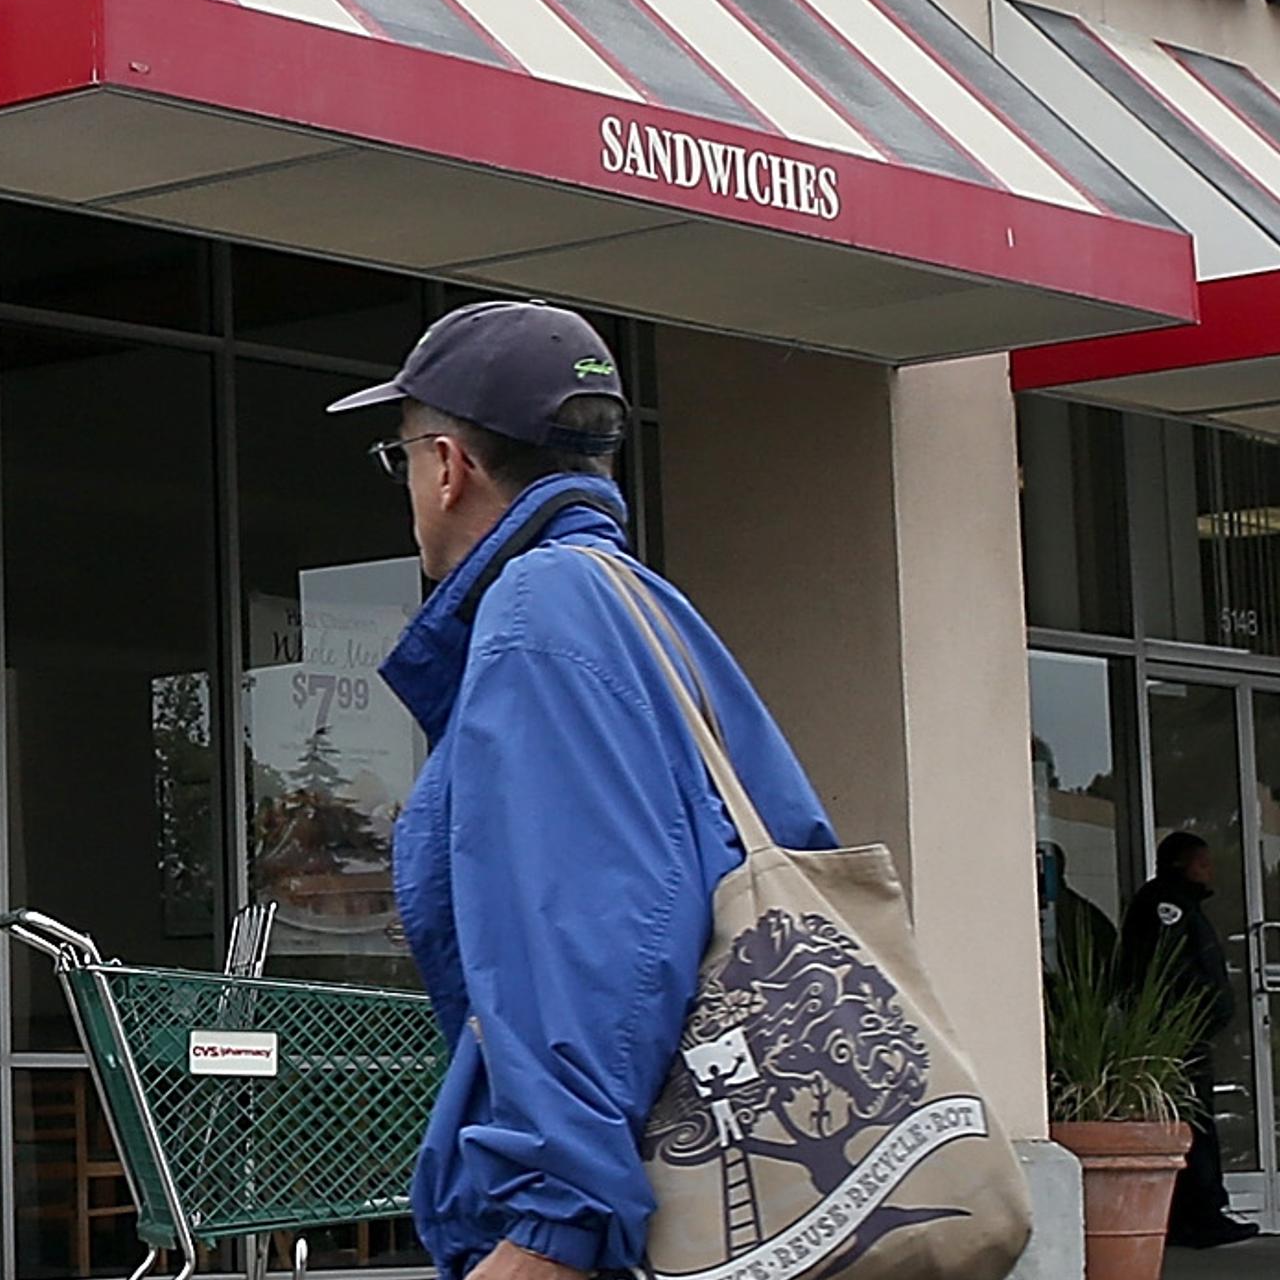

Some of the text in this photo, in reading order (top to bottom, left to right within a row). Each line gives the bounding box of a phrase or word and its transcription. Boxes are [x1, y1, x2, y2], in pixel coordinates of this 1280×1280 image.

[600, 115, 840, 220] SANDWICHES
[1219, 607, 1259, 636] 5148
[772, 1204, 850, 1269] REUSE
[845, 1123, 929, 1209] RECYCLE
[928, 1106, 974, 1133] ROT
